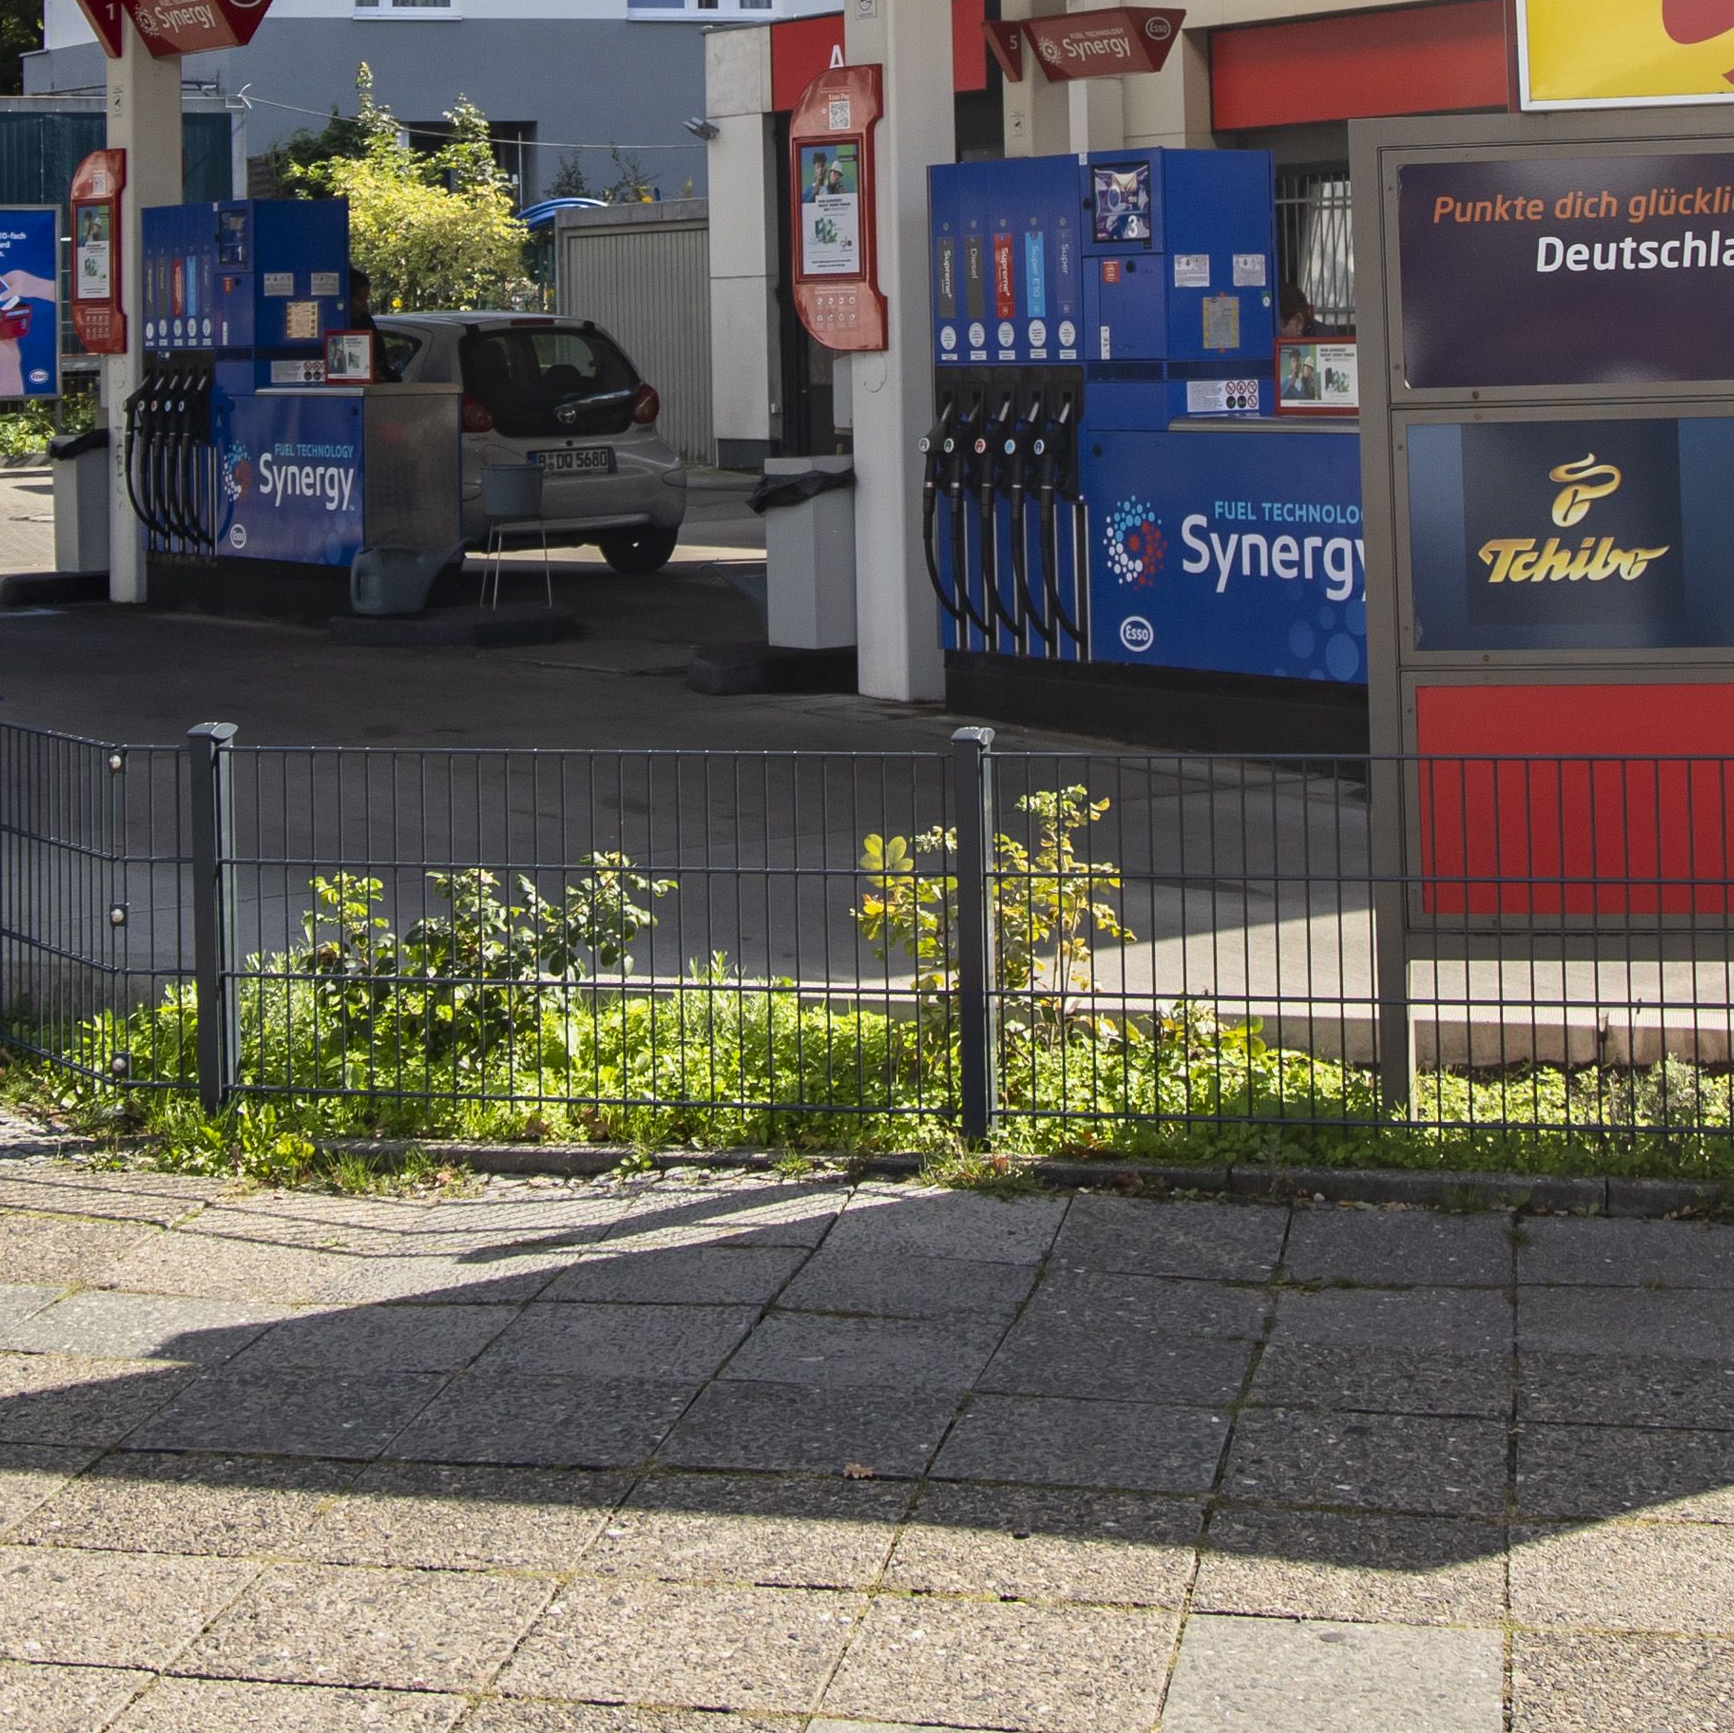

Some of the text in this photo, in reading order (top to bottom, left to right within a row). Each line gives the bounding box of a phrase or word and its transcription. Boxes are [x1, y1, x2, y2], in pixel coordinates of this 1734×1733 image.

[104, 2, 116, 21] 1
[155, 3, 216, 34] Synergy
[1149, 21, 1168, 34] Esso
[1008, 34, 1018, 50] 5
[1062, 37, 1131, 62] Synergy
[1432, 191, 1543, 225] Punkte
[1554, 188, 1617, 220] dich
[1127, 214, 1138, 238] 3
[971, 248, 979, 279] Diesel
[1060, 243, 1069, 275] Super
[274, 443, 354, 460] FUEL TECHNOLOGY
[575, 450, 608, 469] 5680
[259, 452, 355, 512] Synergy
[1214, 500, 1364, 525] FUEL TECHNOLO
[1478, 536, 1671, 584] Tchibo
[1125, 626, 1150, 641] Esso
